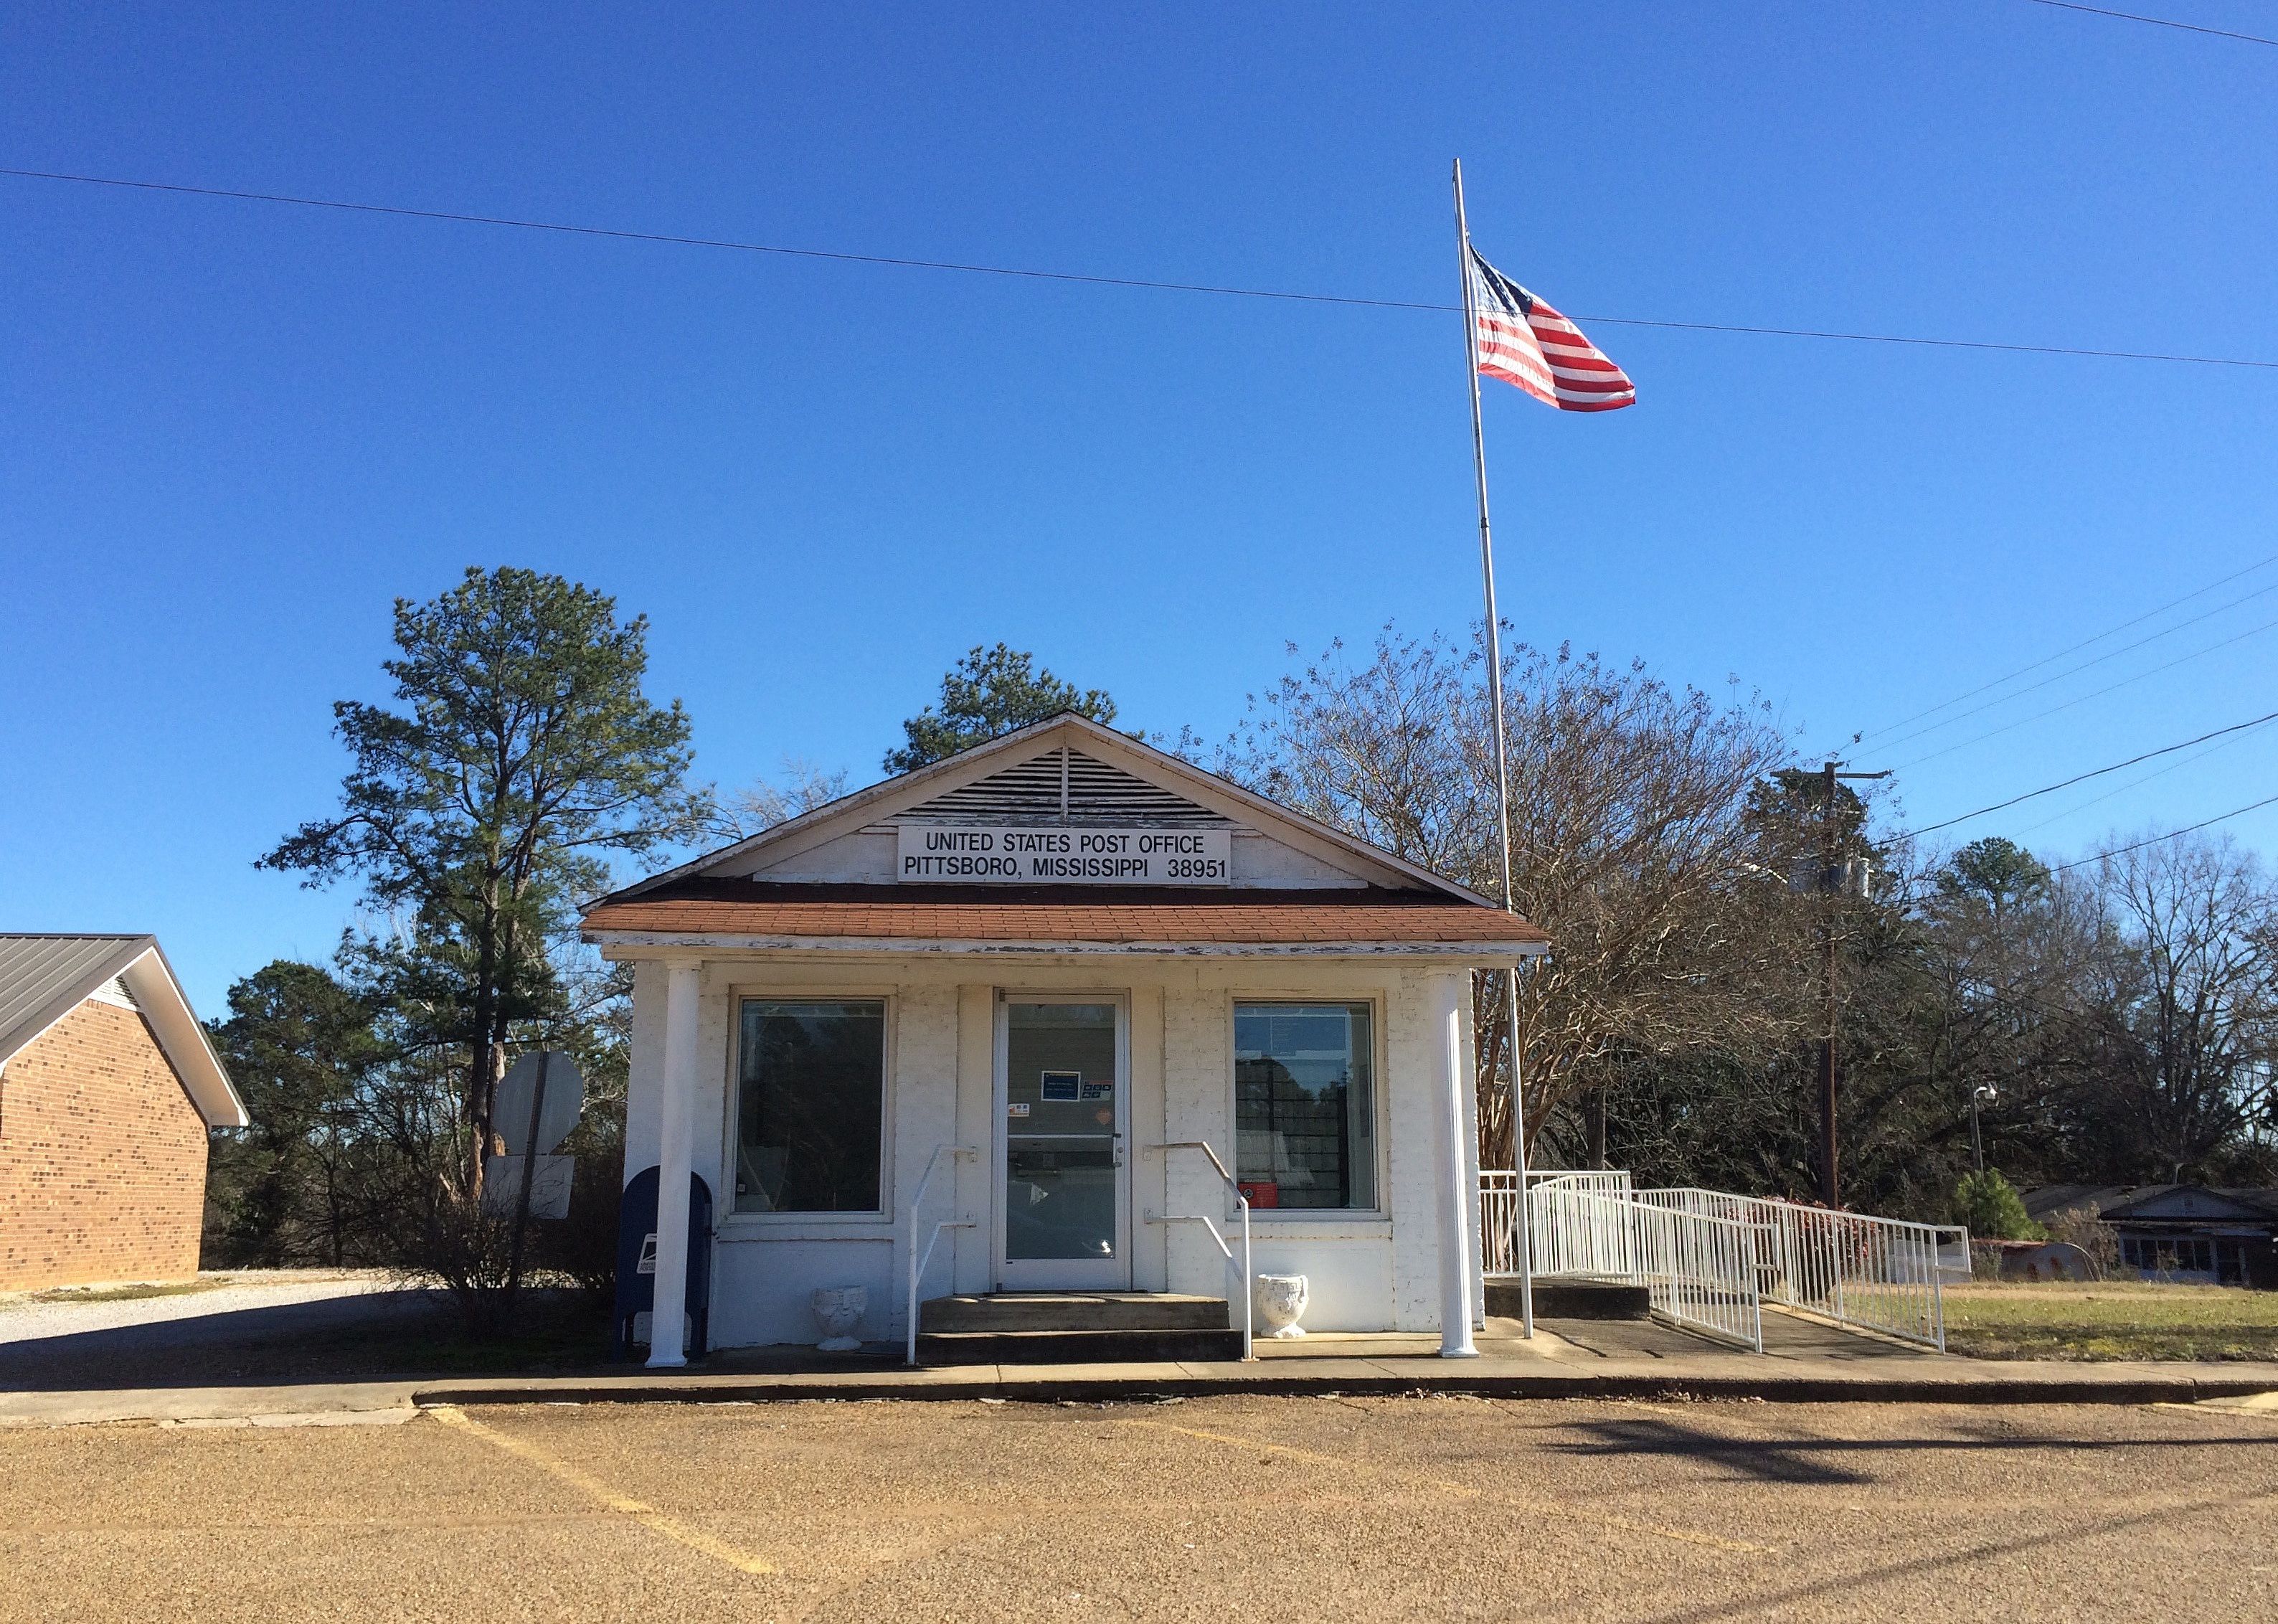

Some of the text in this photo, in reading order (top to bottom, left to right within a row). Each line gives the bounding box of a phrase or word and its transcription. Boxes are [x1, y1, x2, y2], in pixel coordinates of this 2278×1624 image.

[926, 832, 1204, 854] UNITED STATES POST OFFICE
[904, 856, 1226, 879] PITTSBORO, MISSISSIPPI 38951
